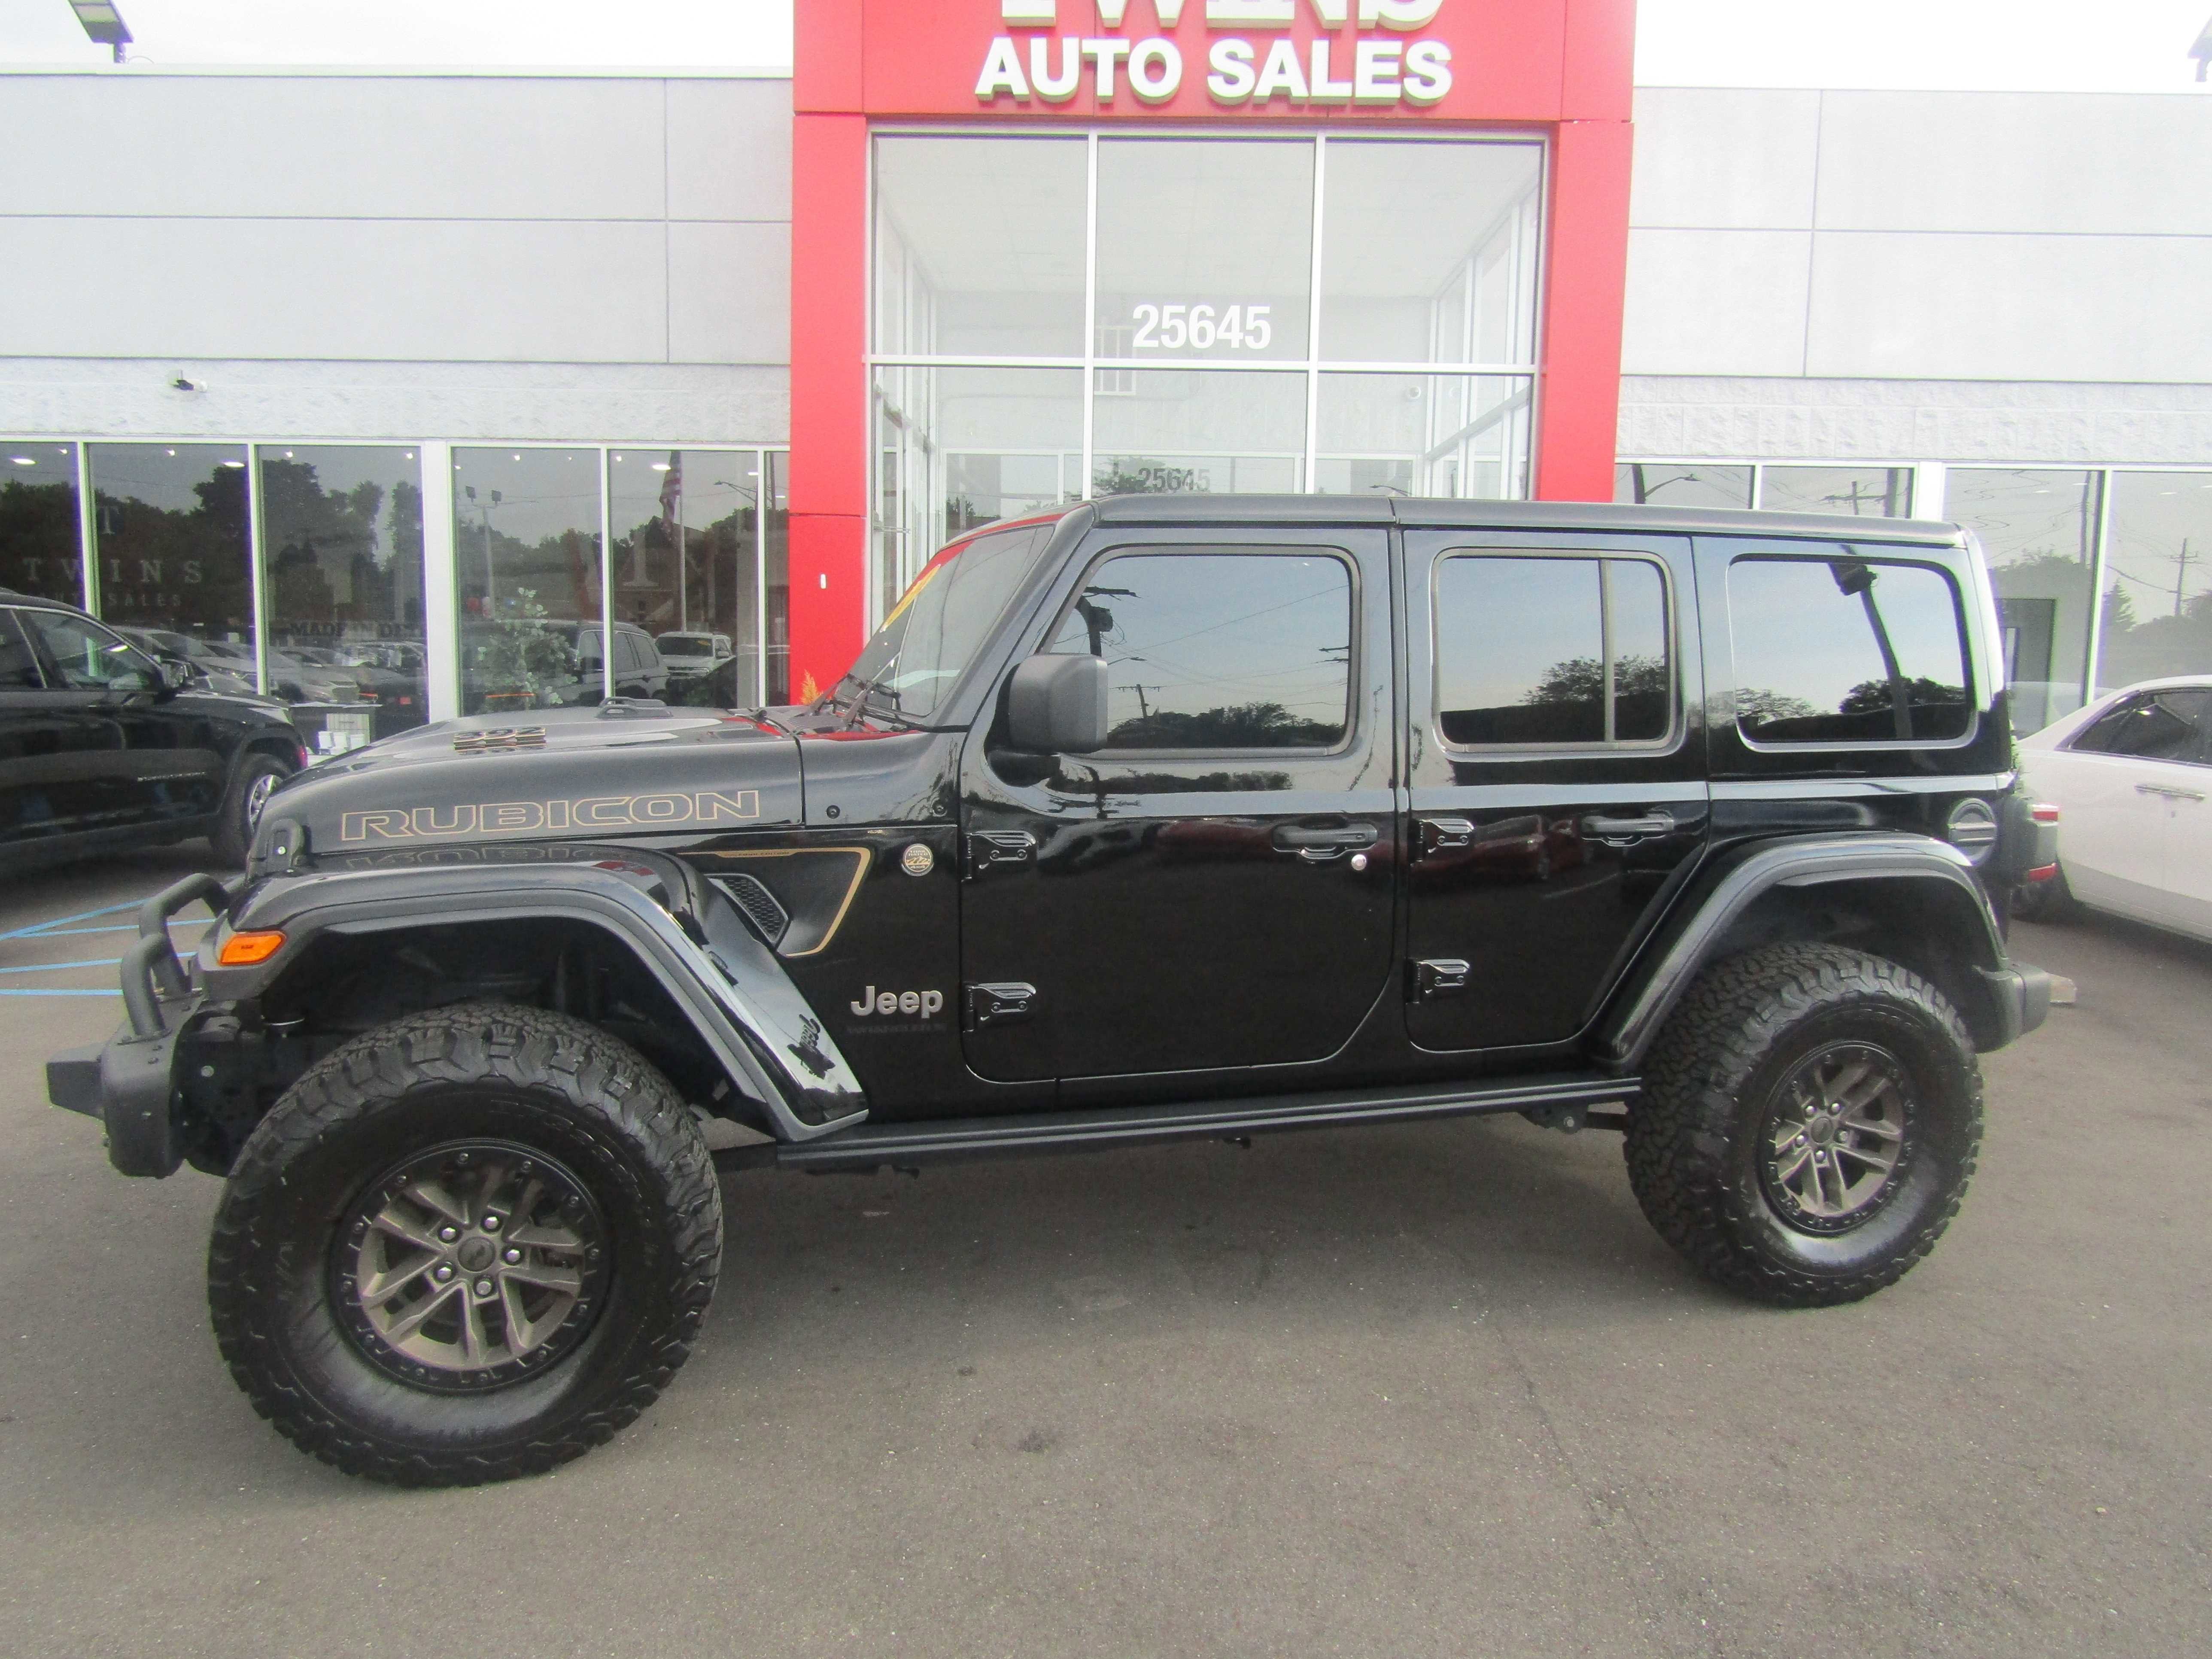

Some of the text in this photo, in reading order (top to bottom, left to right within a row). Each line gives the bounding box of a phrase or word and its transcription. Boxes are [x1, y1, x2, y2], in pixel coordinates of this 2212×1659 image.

[975, 36, 1452, 106] AUTO SALES
[1132, 304, 1271, 349] 25645
[342, 790, 760, 841] RUBICON
[851, 986, 943, 1019] Jeep
